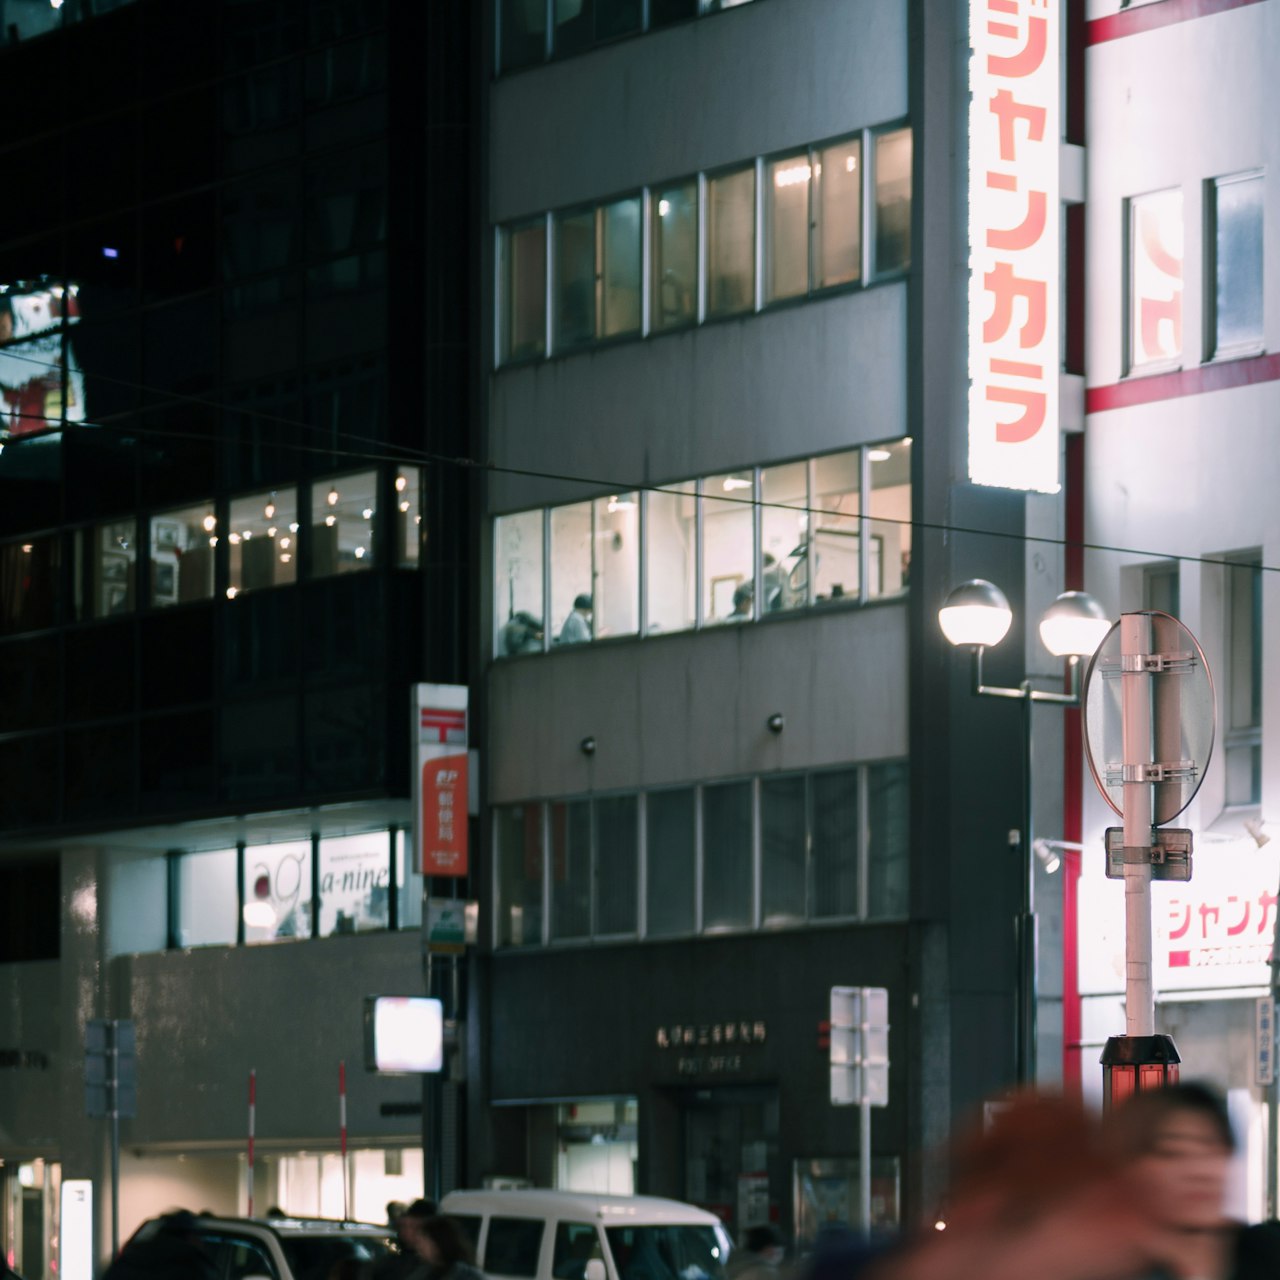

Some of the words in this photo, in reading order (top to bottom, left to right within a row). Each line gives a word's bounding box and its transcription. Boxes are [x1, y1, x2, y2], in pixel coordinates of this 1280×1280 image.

[983, 0, 1047, 444] ジャンカラ
